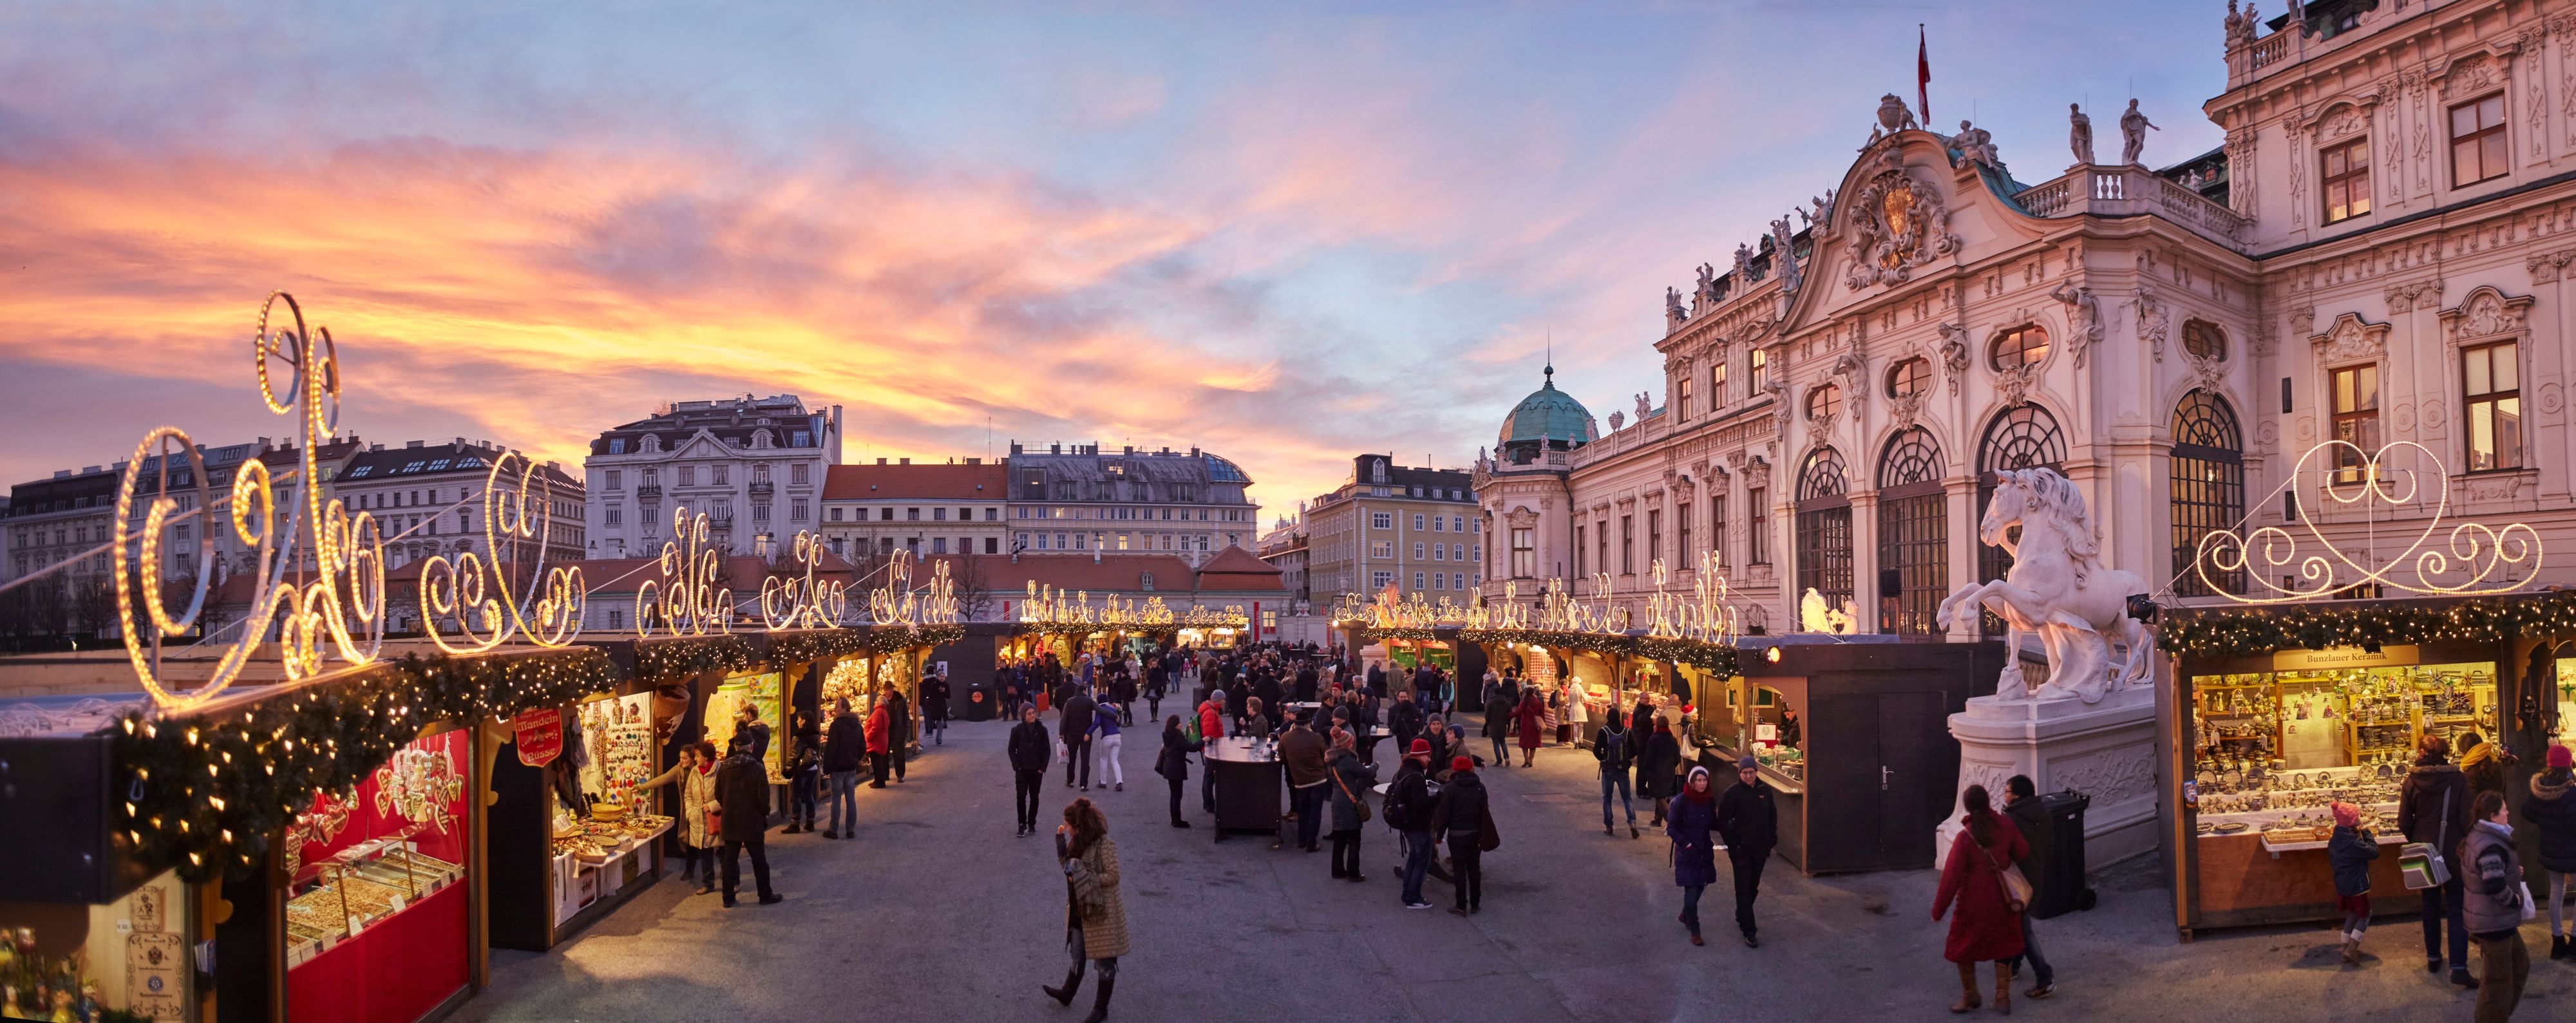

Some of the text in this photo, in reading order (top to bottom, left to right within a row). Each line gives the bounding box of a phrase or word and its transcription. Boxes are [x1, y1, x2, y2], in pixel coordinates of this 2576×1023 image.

[2307, 652, 2387, 662] Bunzlauer Keramik
[517, 715, 558, 731] Mandeln
[527, 748, 555, 762] Nüsse
